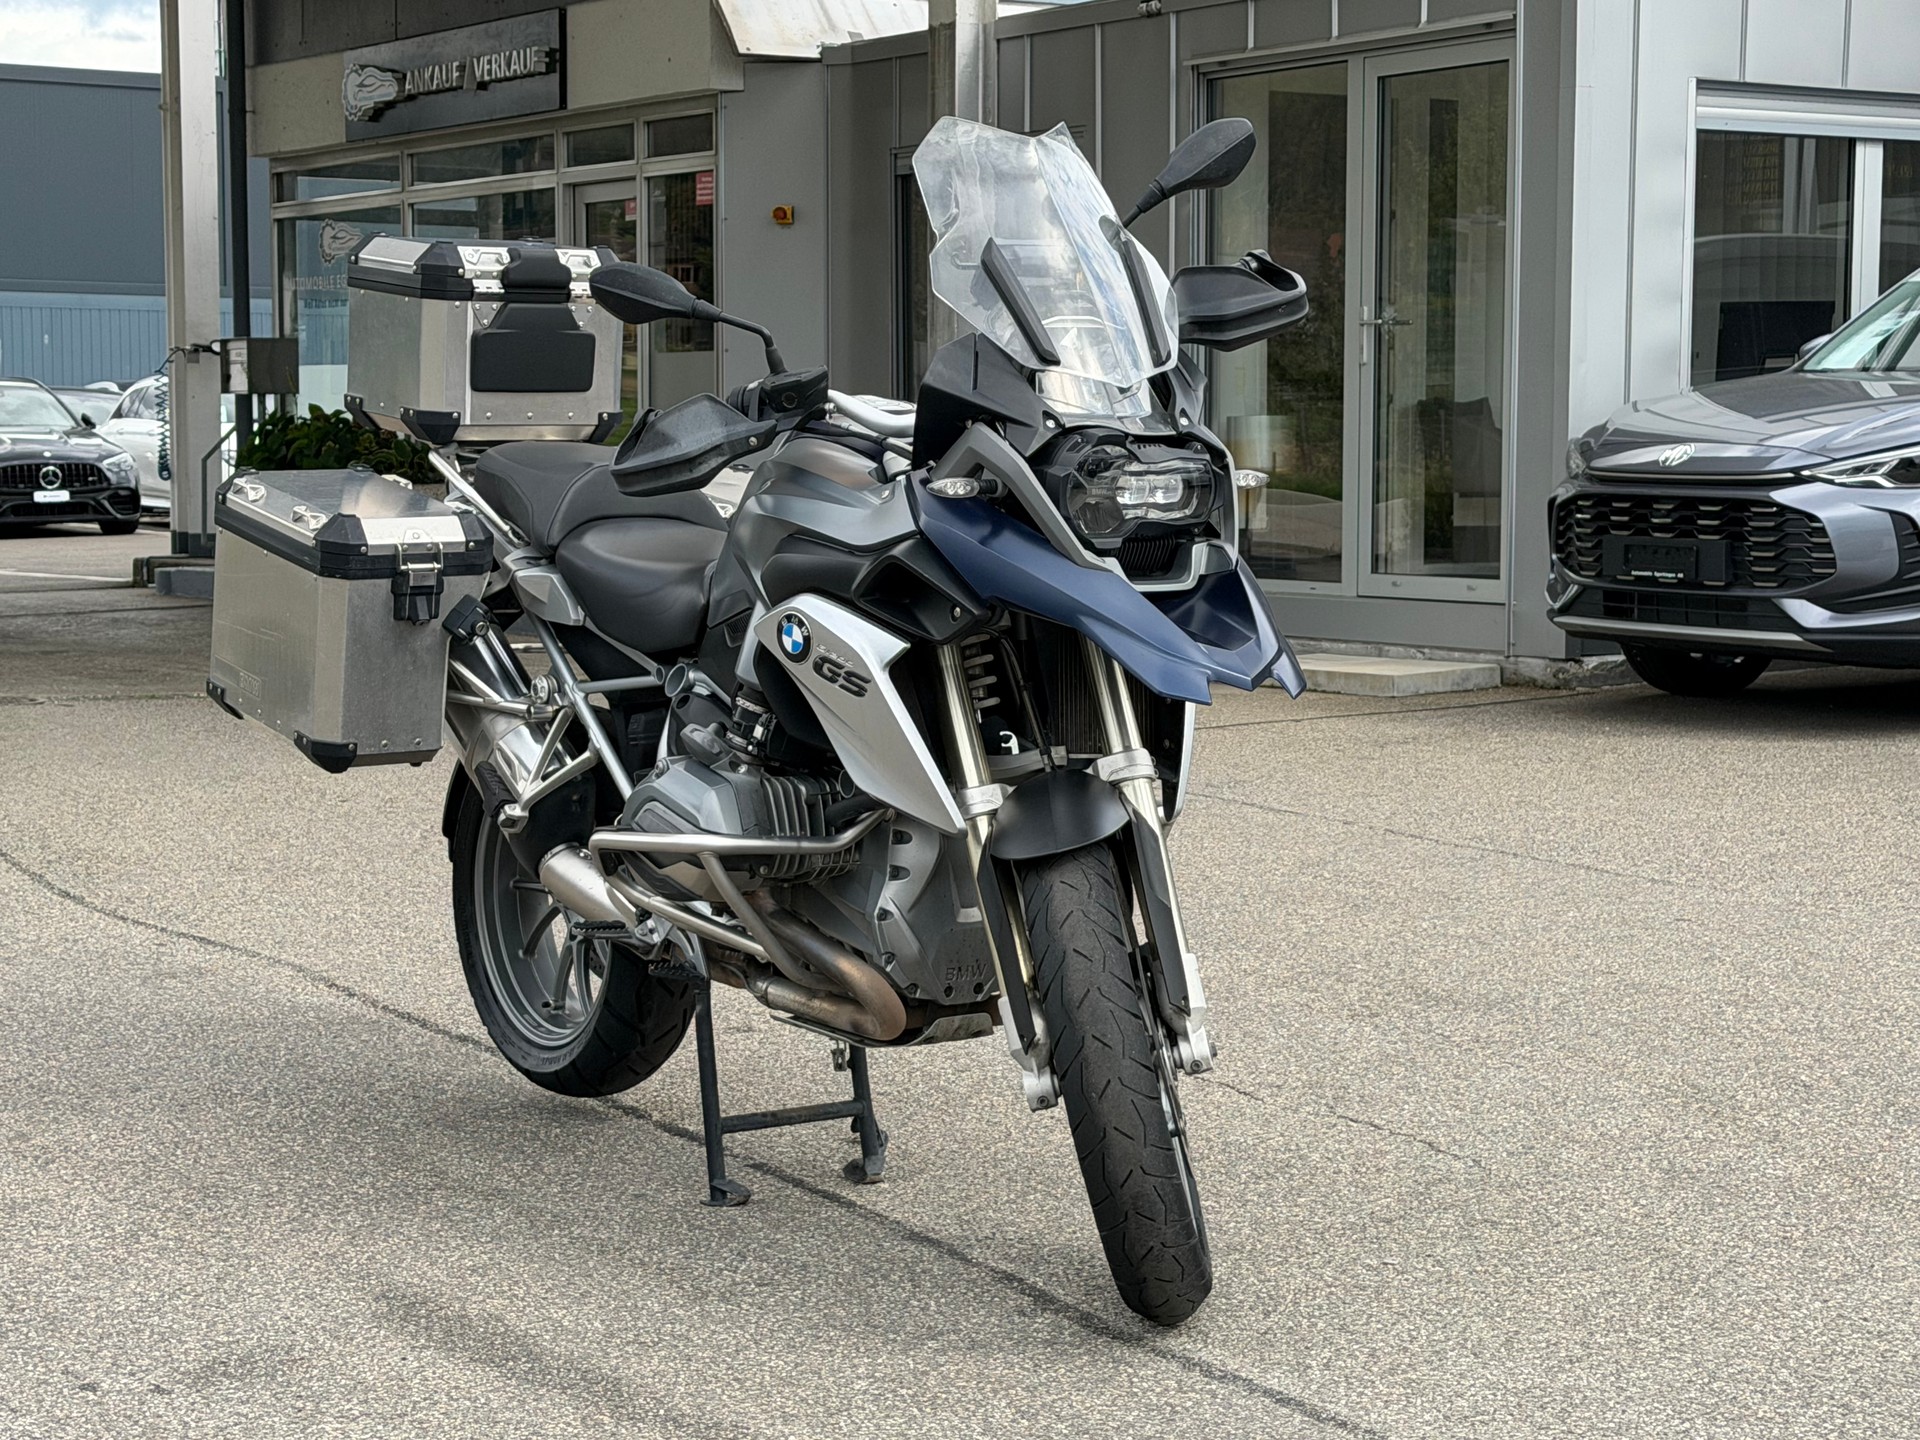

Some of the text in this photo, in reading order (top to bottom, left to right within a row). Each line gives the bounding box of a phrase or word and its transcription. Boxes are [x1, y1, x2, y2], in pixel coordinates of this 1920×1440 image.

[405, 61, 461, 95] ANKAUF
[473, 46, 545, 82] VERKAUF
[781, 615, 809, 637] BMW
[812, 655, 872, 698] GS
[945, 963, 987, 981] BMW
